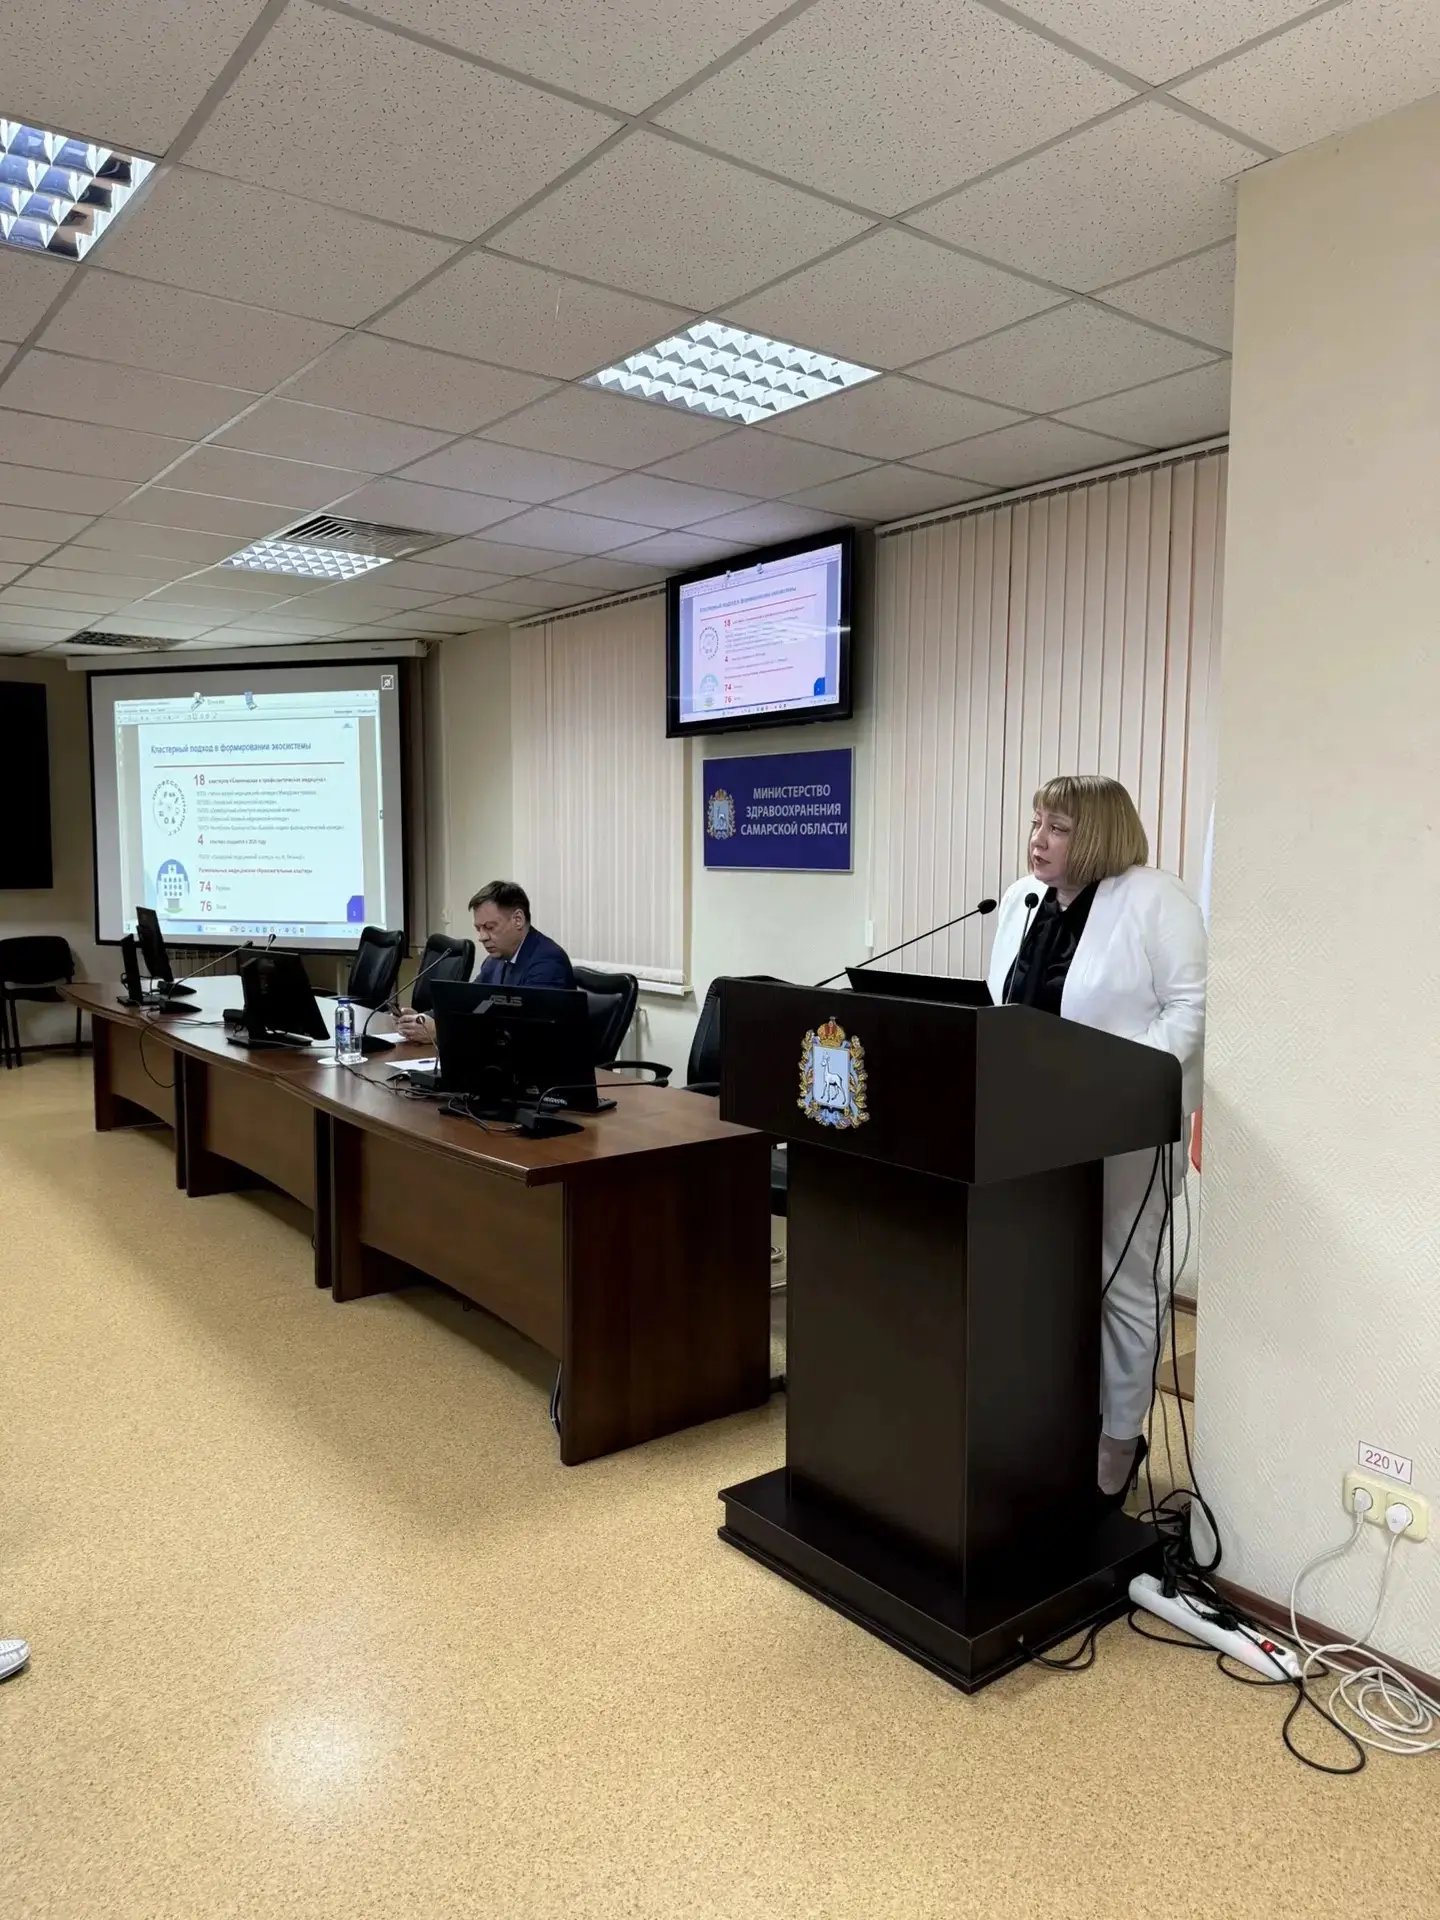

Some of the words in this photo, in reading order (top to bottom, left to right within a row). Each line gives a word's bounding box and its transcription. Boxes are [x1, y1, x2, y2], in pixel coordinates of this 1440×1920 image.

[724, 683, 732, 692] 74
[724, 695, 732, 704] 76
[151, 744, 189, 756] Кластерный
[189, 744, 214, 754] подход
[271, 742, 312, 751] экосистемы
[193, 774, 206, 786] 18
[753, 784, 831, 800] МИНИСТЕРСТВО
[746, 803, 841, 819] ЗДРАВООХРАНЕНИЯ
[740, 821, 798, 836] САМАРСКОЙ
[800, 822, 848, 836] ОБЛАСТИ
[197, 833, 204, 846] 4
[199, 880, 212, 893] 74
[200, 900, 212, 912] 76
[489, 994, 523, 1007] ASUS
[1365, 1449, 1390, 1470] 220
[1393, 1459, 1405, 1474] V
